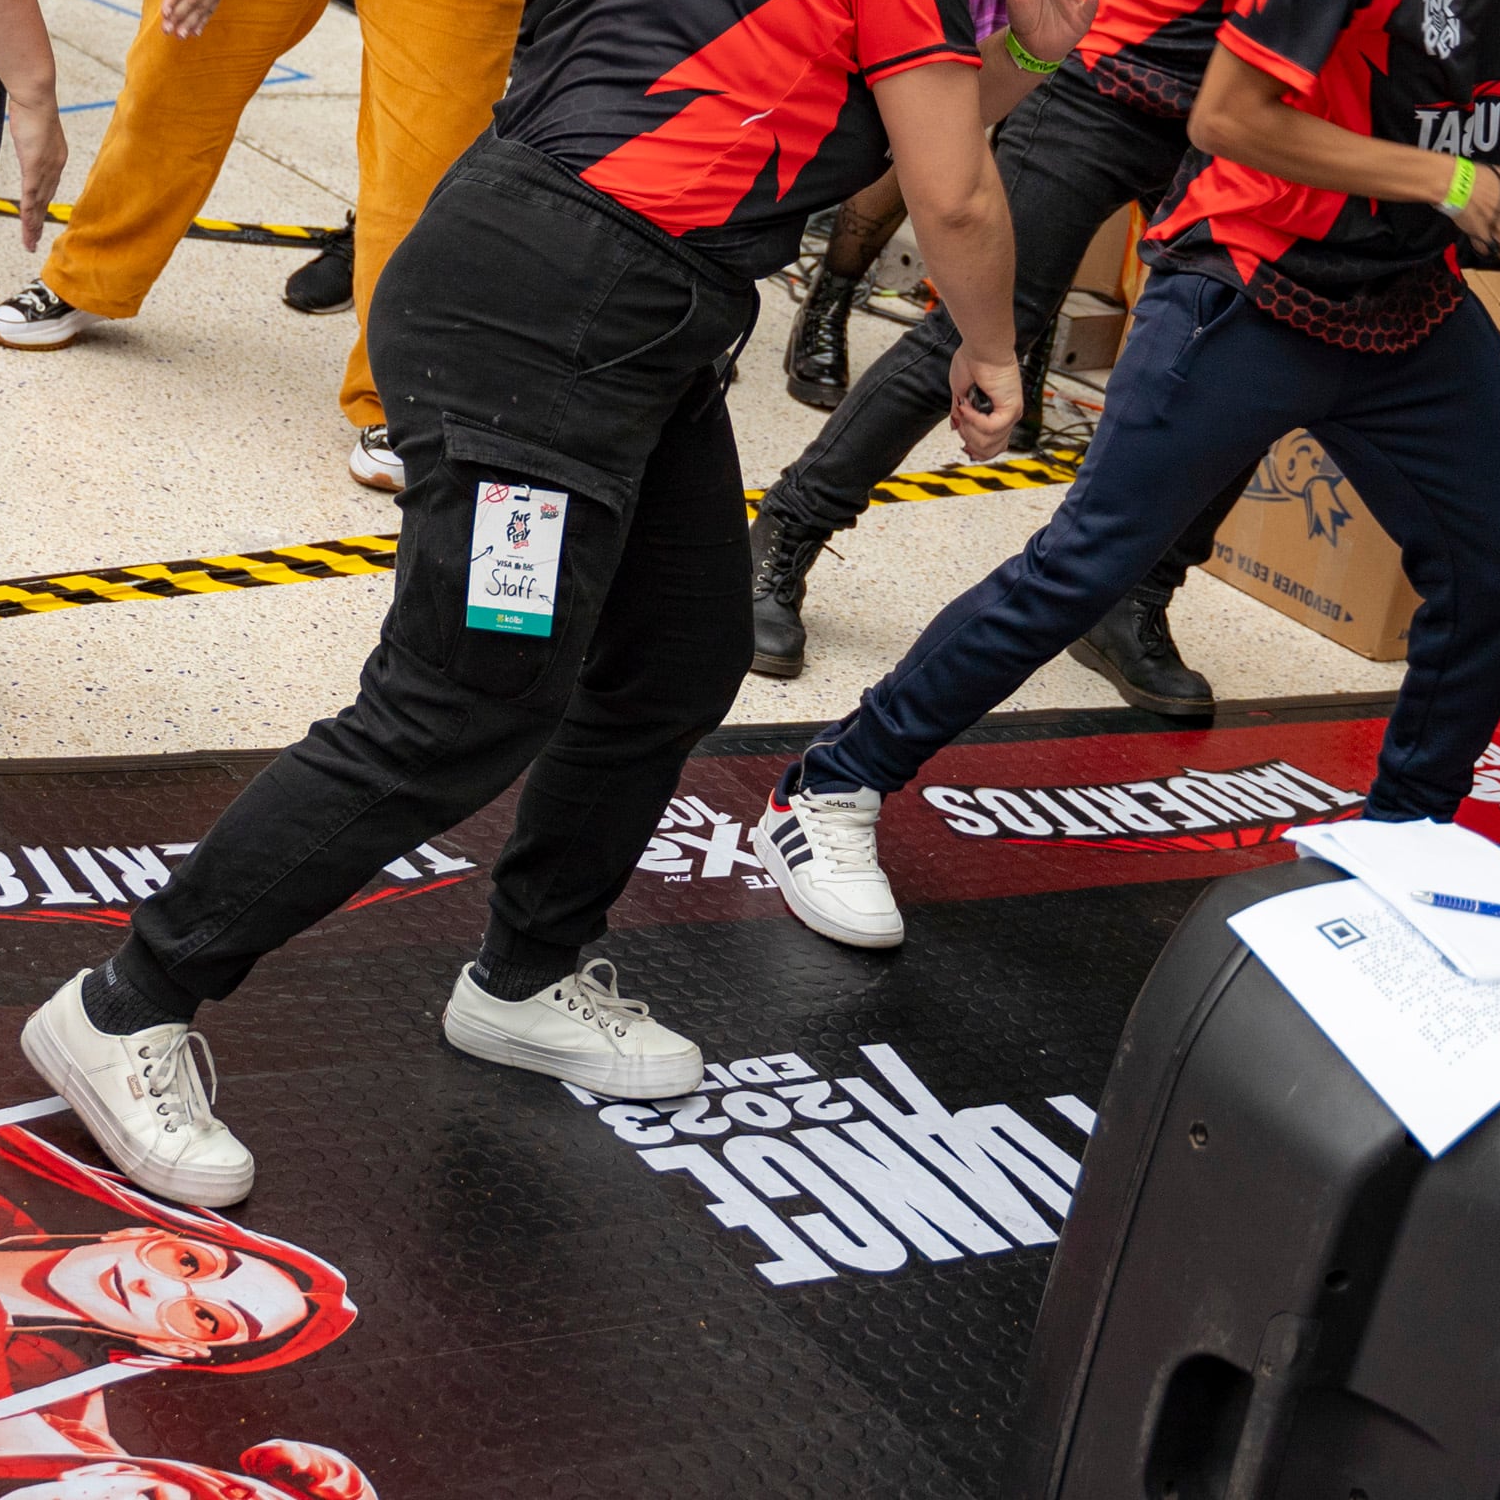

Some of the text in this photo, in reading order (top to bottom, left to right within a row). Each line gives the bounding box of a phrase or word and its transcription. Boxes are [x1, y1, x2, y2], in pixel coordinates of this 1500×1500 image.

[485, 568, 538, 600] Staff
[1237, 553, 1270, 583] ESTA
[1272, 571, 1342, 622] DEVOLVER
[921, 758, 1370, 839] TAQUERITOS
[663, 873, 692, 883] FM
[598, 1078, 854, 1146] 2023
